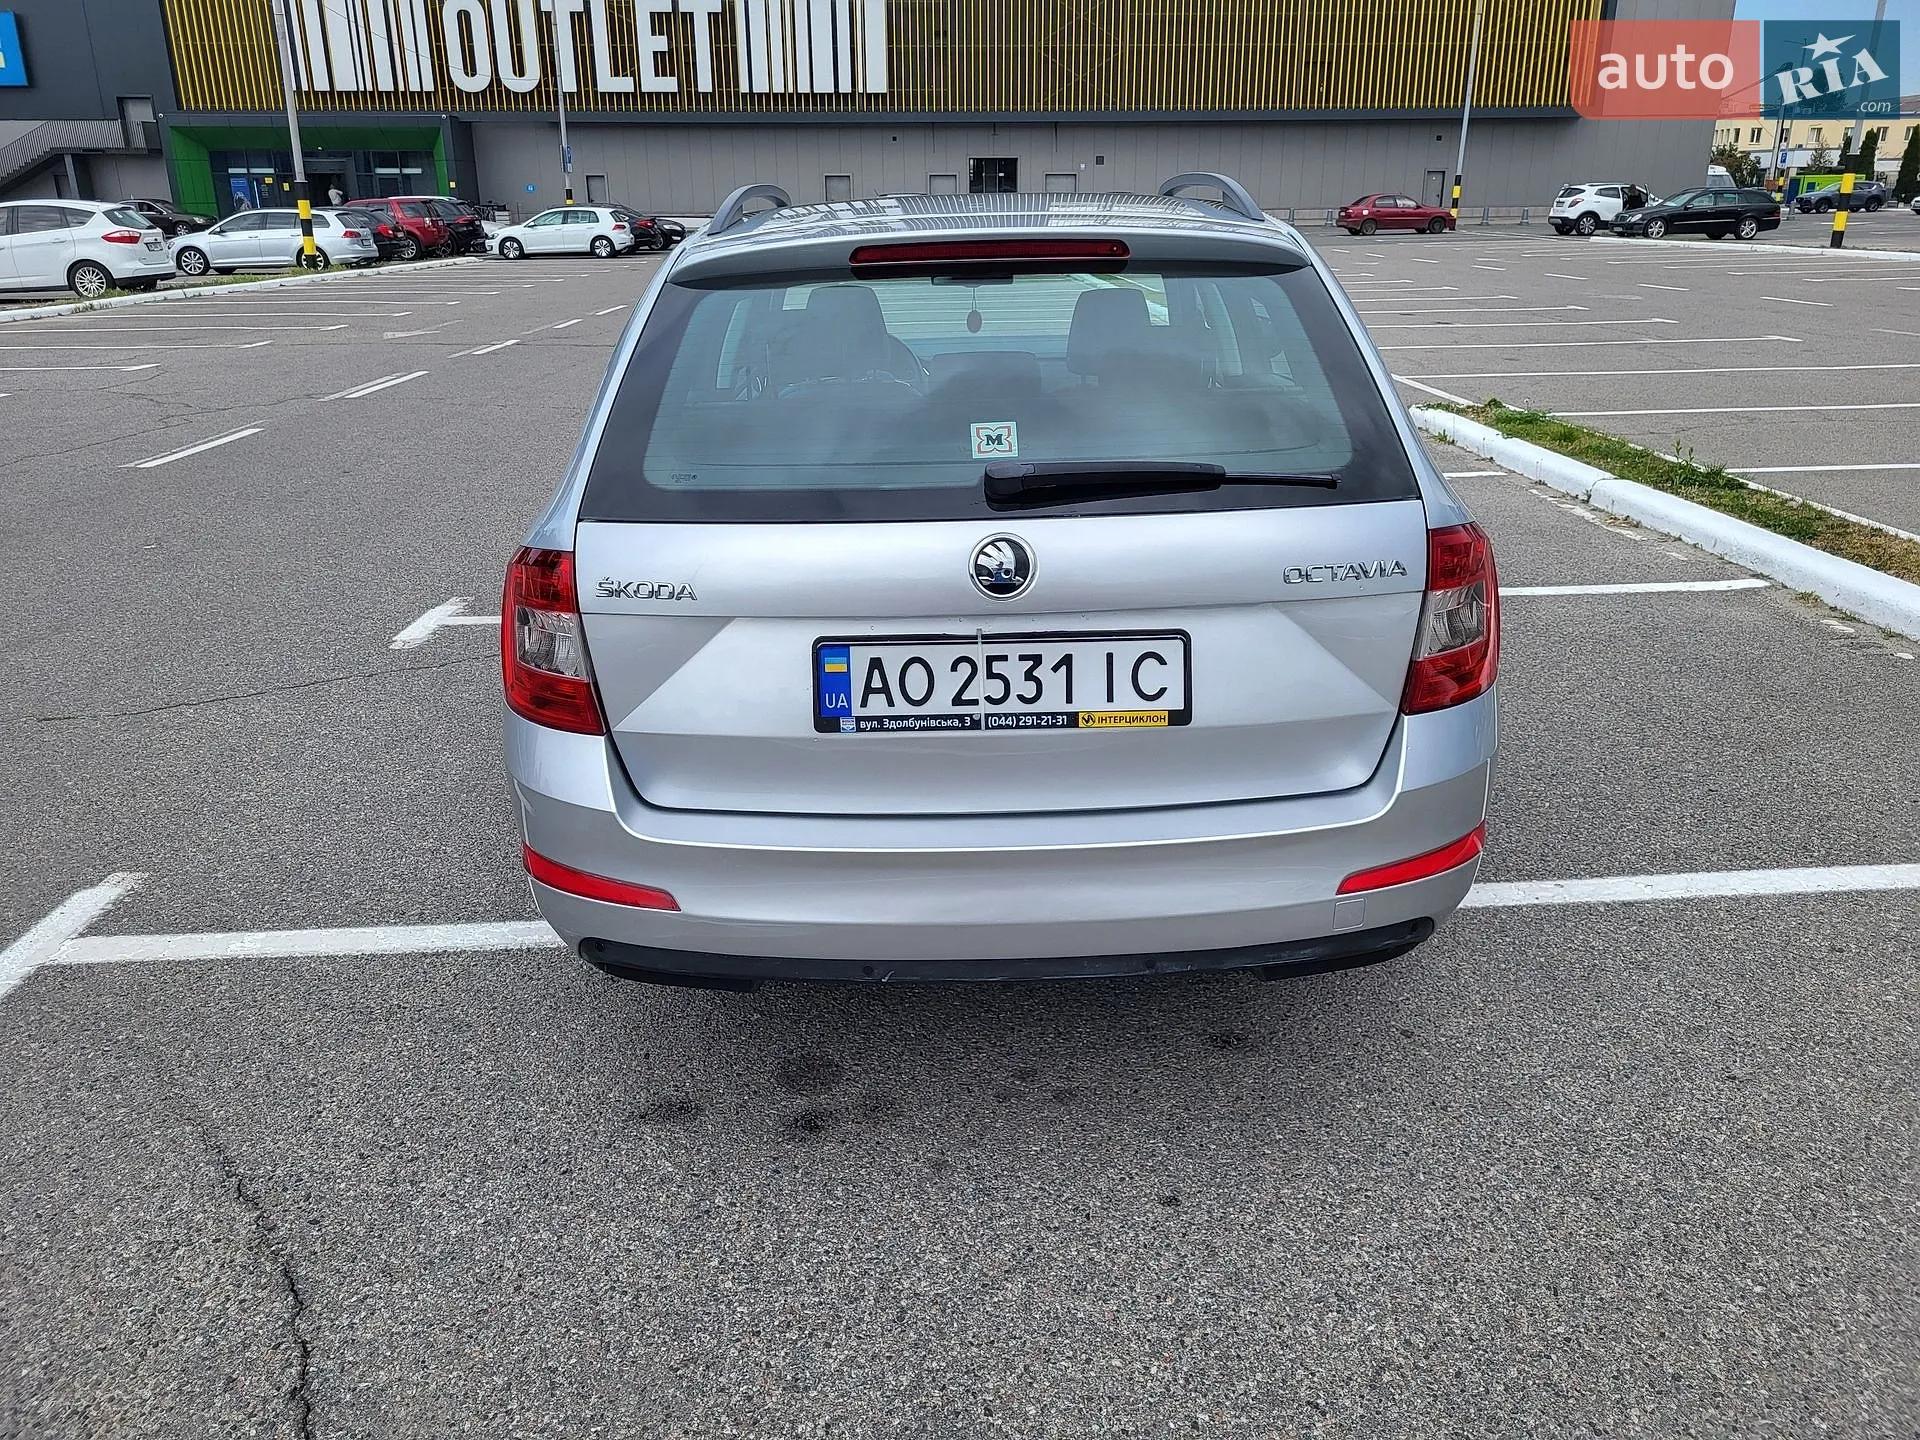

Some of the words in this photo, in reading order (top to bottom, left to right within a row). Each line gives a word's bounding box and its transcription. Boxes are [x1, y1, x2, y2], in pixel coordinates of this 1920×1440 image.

[442, 0, 723, 93] OUTLET
[984, 433, 1004, 446] M
[1283, 559, 1408, 584] OCTAVIA
[595, 577, 698, 601] ŠKODA
[950, 653, 1073, 707] 2531
[825, 693, 849, 709] UA
[860, 720, 881, 731] вул.
[882, 717, 962, 730] Здолбунівська,
[964, 716, 972, 727] 3
[987, 715, 1017, 728] (044)
[1018, 714, 1067, 727] 291-21-31
[1097, 714, 1167, 725] ІНТЕРЦИКЛОН
